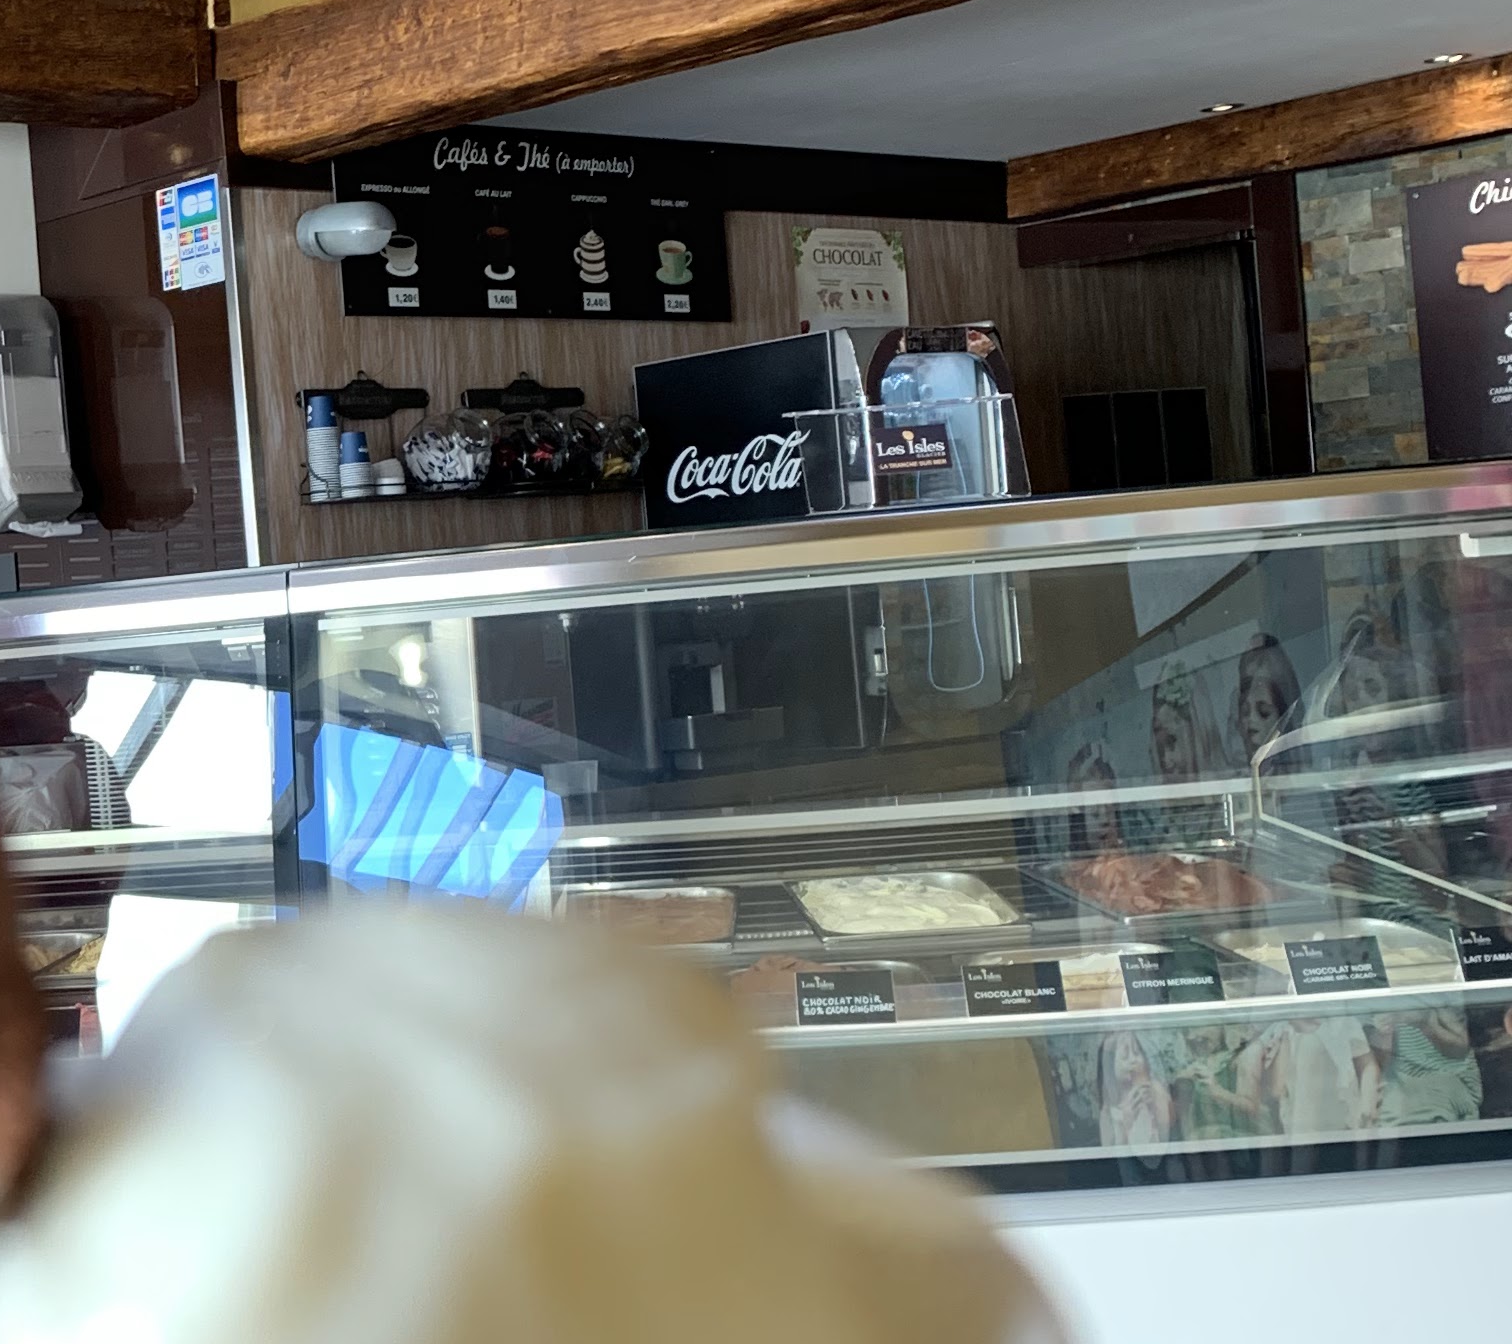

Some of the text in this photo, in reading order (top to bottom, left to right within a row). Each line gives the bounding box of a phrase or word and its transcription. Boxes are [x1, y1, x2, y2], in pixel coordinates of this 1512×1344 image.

[434, 137, 488, 171] Cafés
[494, 141, 511, 166] &
[516, 142, 550, 171] Thé
[573, 156, 634, 178] emporter)
[813, 248, 883, 266] CHOCOLAT
[876, 438, 946, 457] Les Isles
[666, 429, 811, 503] Coca-Cola
[1302, 965, 1350, 976] CHOCOLAT
[1132, 979, 1166, 988] CITRON
[974, 987, 1056, 999] CHOCOLAT BLANC
[802, 996, 852, 1007] CHOCOLAT
